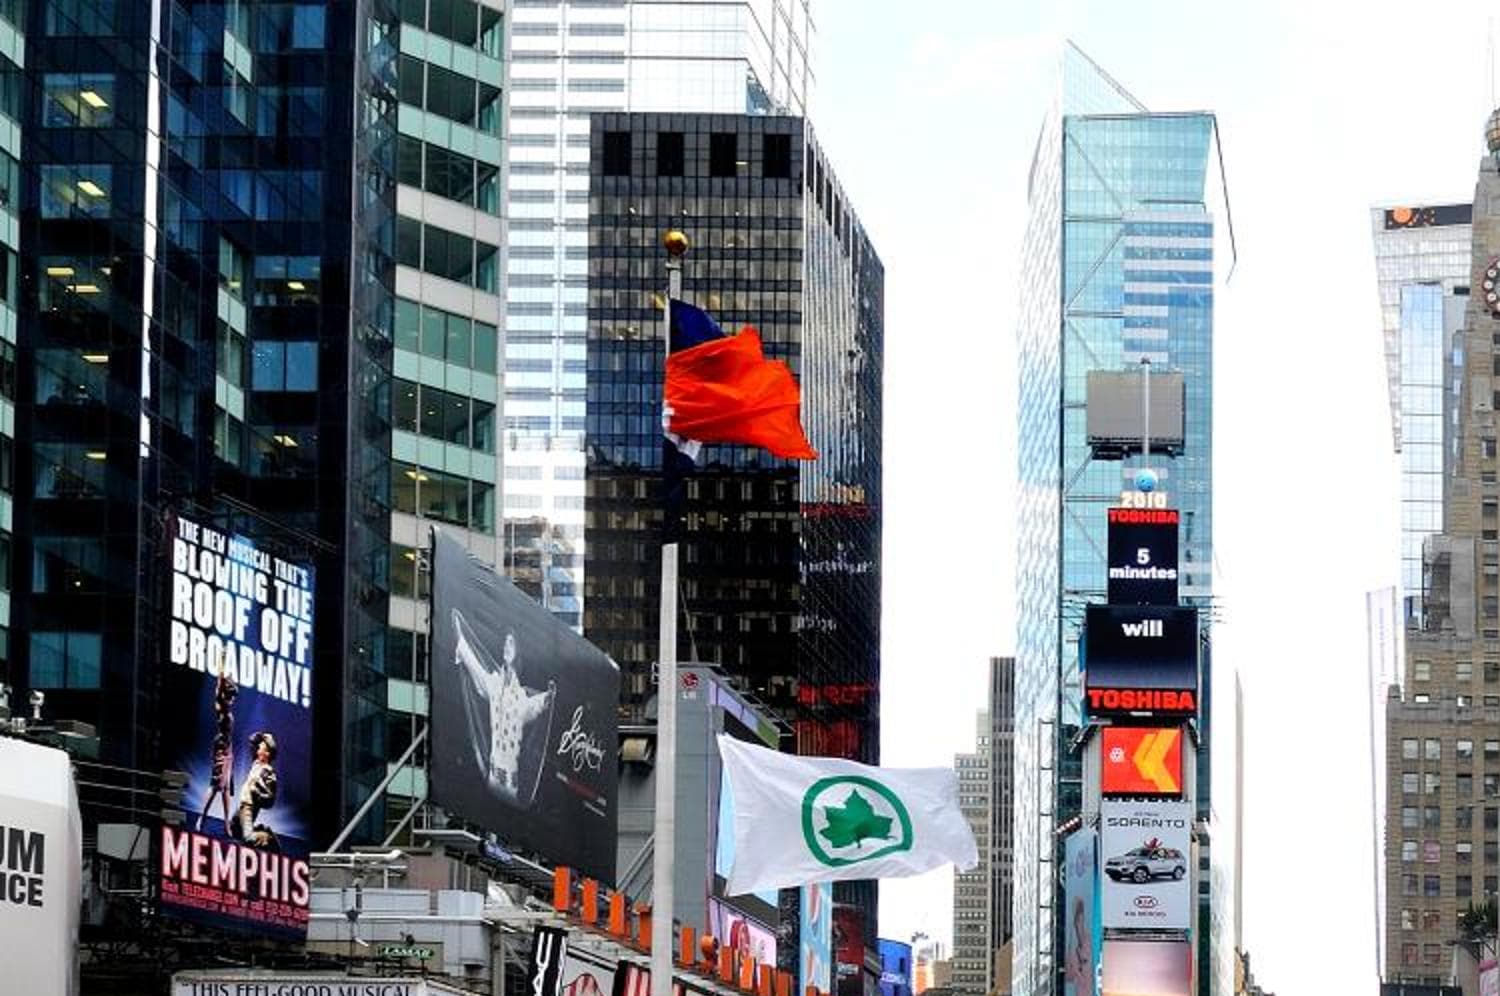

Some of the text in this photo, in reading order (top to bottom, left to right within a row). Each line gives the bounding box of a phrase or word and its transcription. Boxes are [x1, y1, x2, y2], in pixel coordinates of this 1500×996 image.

[1120, 492, 1167, 508] 2010
[1109, 510, 1178, 523] TOSHIBA
[178, 517, 199, 544] THE
[202, 527, 227, 553] NEW
[228, 537, 272, 574] MUSICAL
[1137, 548, 1150, 564] 5
[173, 538, 312, 621] BLOWING THE
[1109, 565, 1177, 580] minutes
[172, 571, 312, 663] ROOF OFF
[1122, 619, 1163, 638] will
[171, 619, 312, 708] BROADWAY!
[1088, 689, 1194, 710] TOSHIBA
[1107, 817, 1186, 829] SORENTO
[162, 826, 310, 905] MEMPHIS
